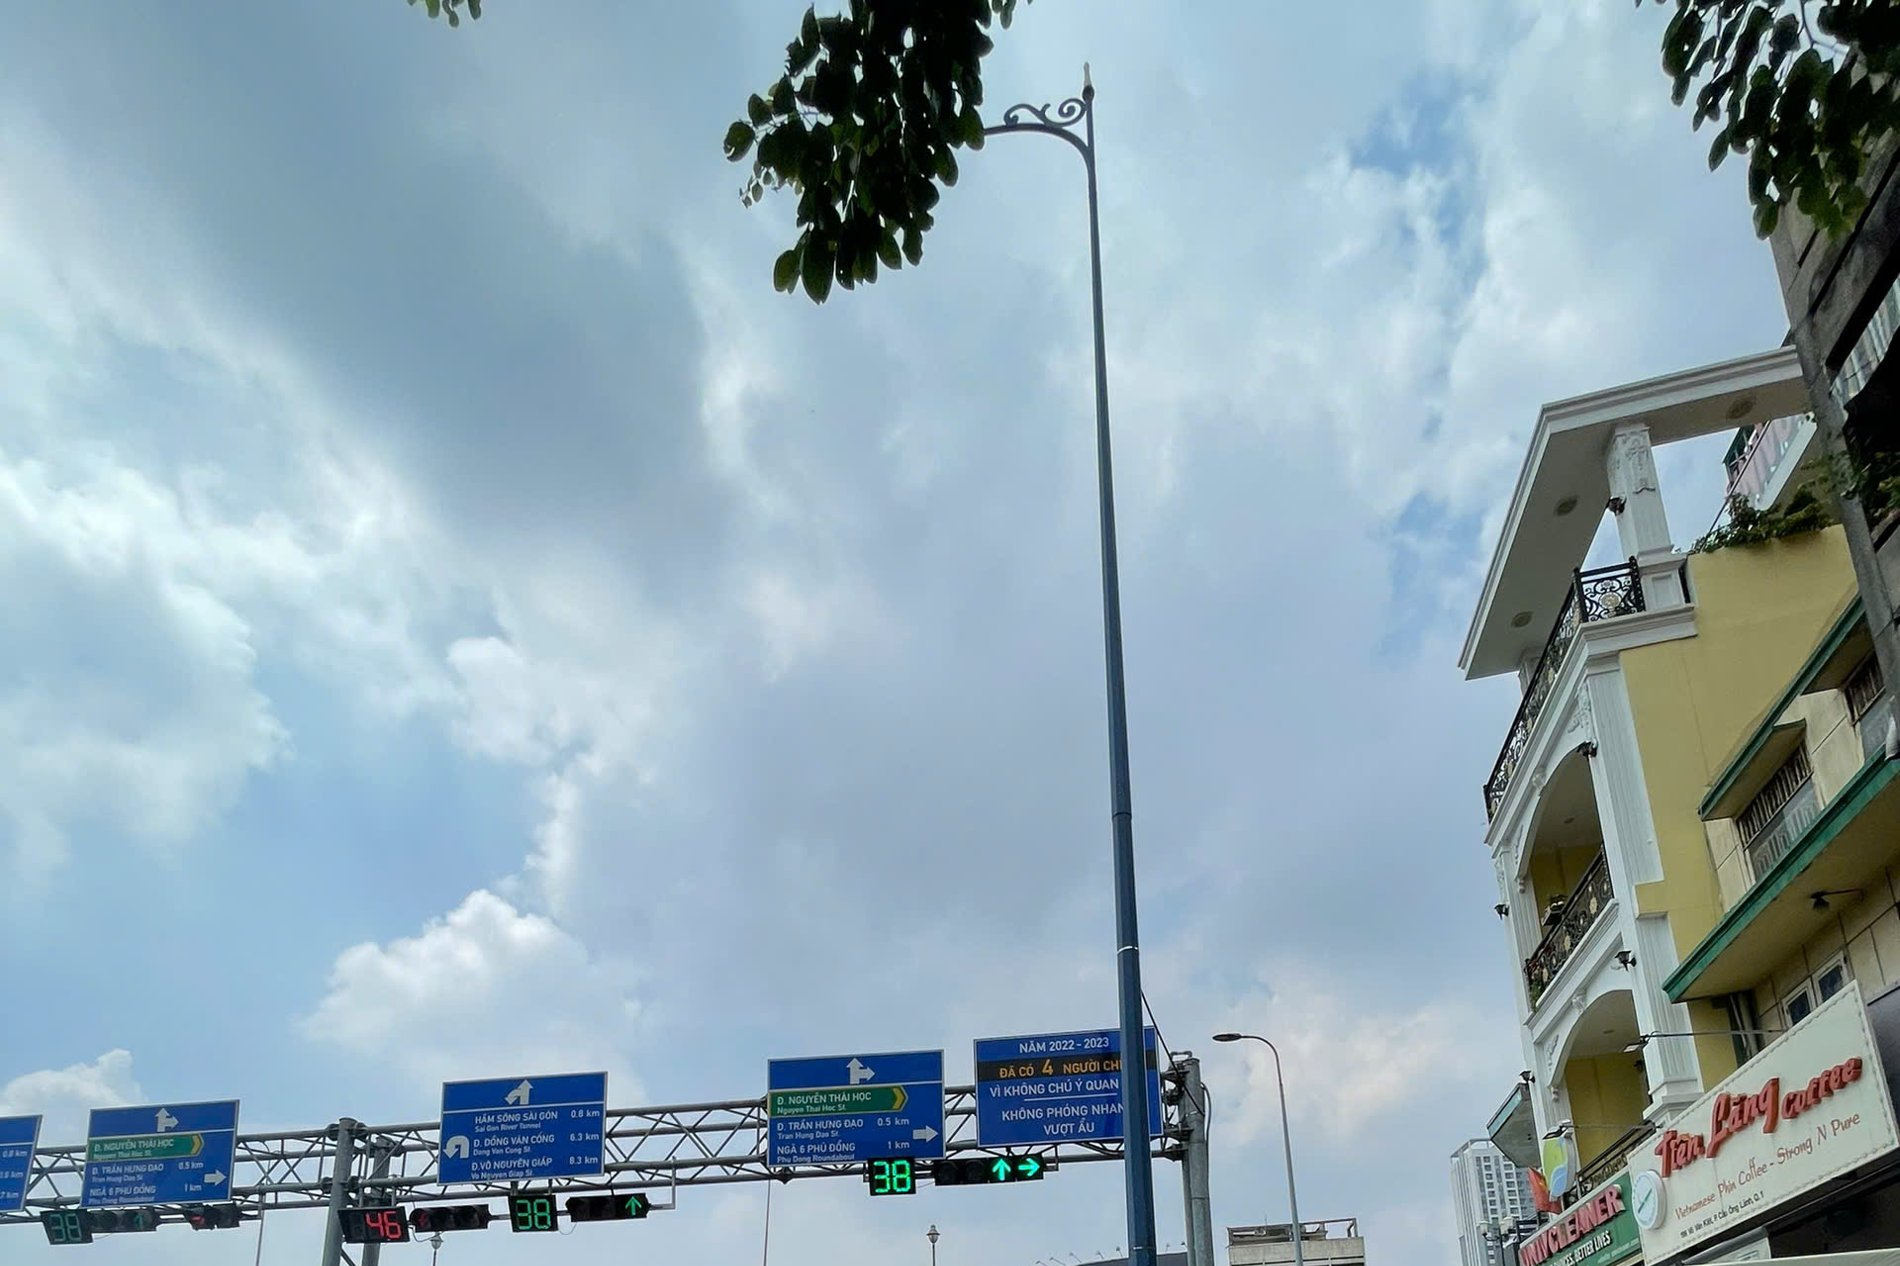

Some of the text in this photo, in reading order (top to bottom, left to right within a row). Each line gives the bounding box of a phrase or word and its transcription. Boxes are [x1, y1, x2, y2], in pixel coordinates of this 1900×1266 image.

[1019, 1041, 1046, 1054] NĂM
[1049, 1040, 1075, 1051] 2022
[1083, 1037, 1109, 1049] 2023
[999, 1064, 1016, 1079] ĐÃ
[1018, 1063, 1035, 1077] CÓ
[1042, 1059, 1053, 1075] 4
[1063, 1059, 1100, 1074] NGƯỜI
[990, 1078, 1119, 1098] VÌ KHÔNG CHÚ Ý QUAN
[852, 1092, 872, 1102] HỌC
[586, 1109, 600, 1117] km
[777, 1107, 804, 1115] Nguyen
[806, 1105, 821, 1113] Thai
[1002, 1103, 1124, 1121] KHÔNG PHÓNG NHAN
[844, 1119, 864, 1130] ĐẠO
[877, 1116, 910, 1127] 0.5 km
[1043, 1121, 1075, 1136] VƯỢT
[585, 1132, 600, 1141] km
[800, 1145, 806, 1153] 6
[887, 1140, 910, 1149] 1 km
[584, 1156, 599, 1164] km
[1675, 1193, 1716, 1219] Vietnamese
[1718, 1178, 1737, 1199] Phin
[1738, 1157, 1768, 1186] Coffee
[1777, 1137, 1813, 1165] Strong
[1817, 1124, 1828, 1145] N
[1831, 1113, 1861, 1136] Pure
[873, 1160, 912, 1193] 38
[516, 1199, 551, 1230] 38
[51, 1213, 82, 1242] 38
[365, 1211, 401, 1239] 46
